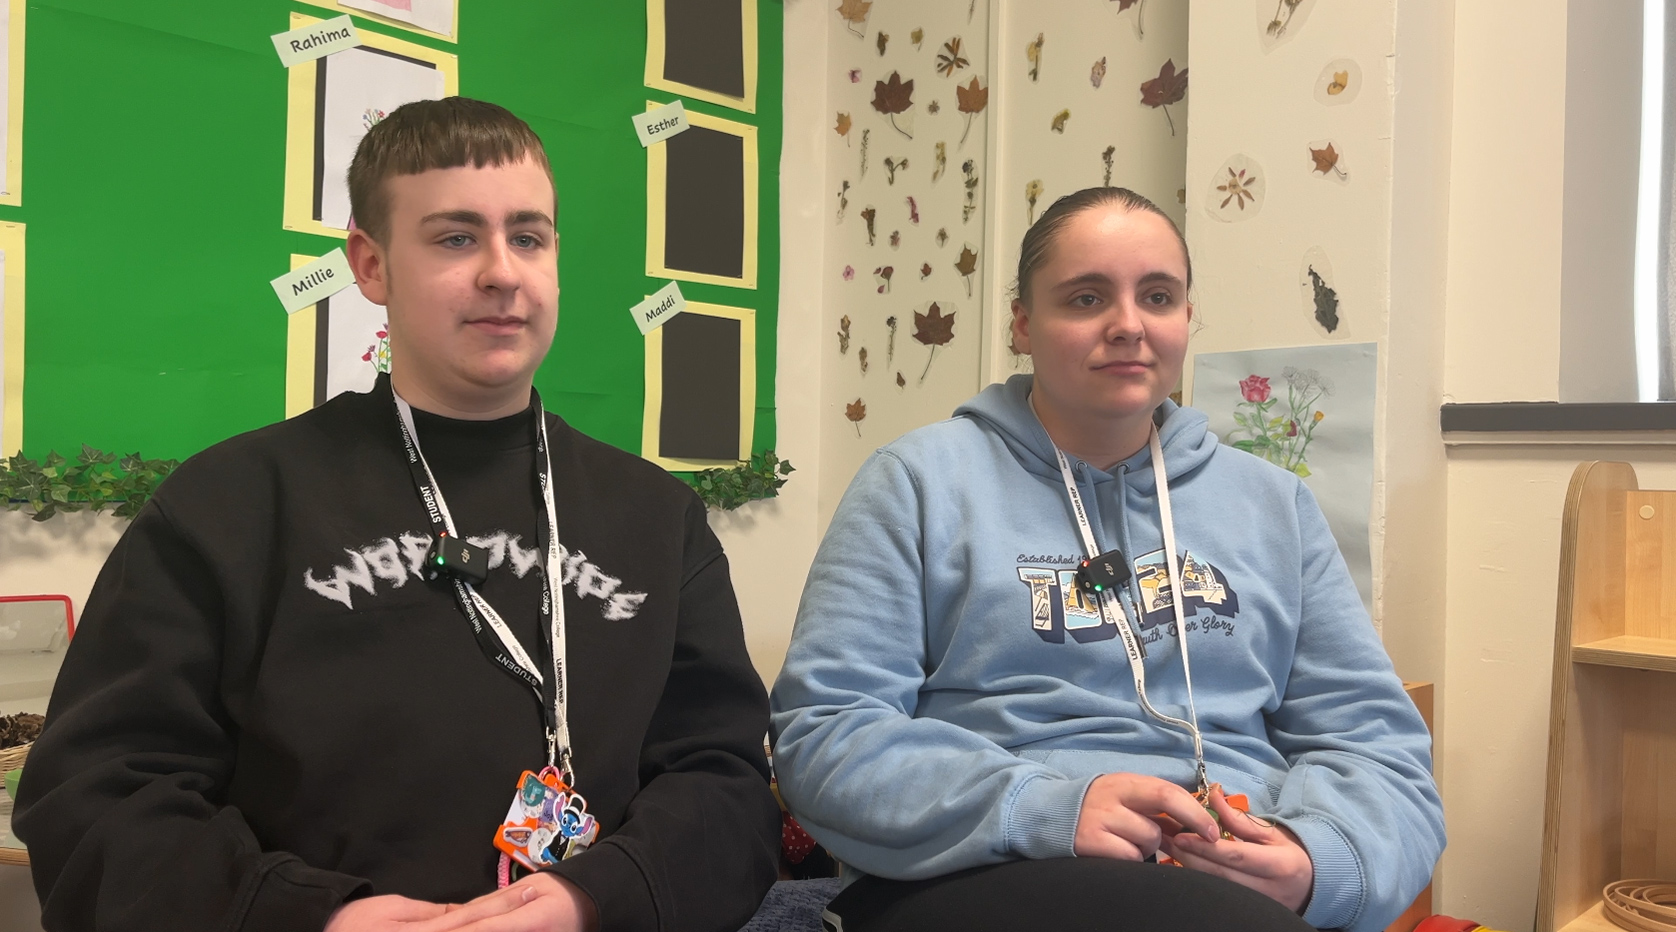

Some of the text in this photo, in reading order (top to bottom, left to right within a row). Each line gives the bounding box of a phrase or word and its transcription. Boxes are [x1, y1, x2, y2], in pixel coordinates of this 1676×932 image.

[289, 27, 352, 54] Rahima
[647, 116, 680, 136] Esther
[290, 265, 335, 297] Millie
[644, 294, 676, 323] Maddi
[419, 485, 442, 524] STUDENT
[1073, 500, 1087, 527] LEARNER
[1016, 553, 1075, 564] Established
[1167, 622, 1199, 637] Oer
[1201, 615, 1236, 637] Glory
[1123, 630, 1138, 660] LEARNER
[495, 653, 538, 686] STUDENT
